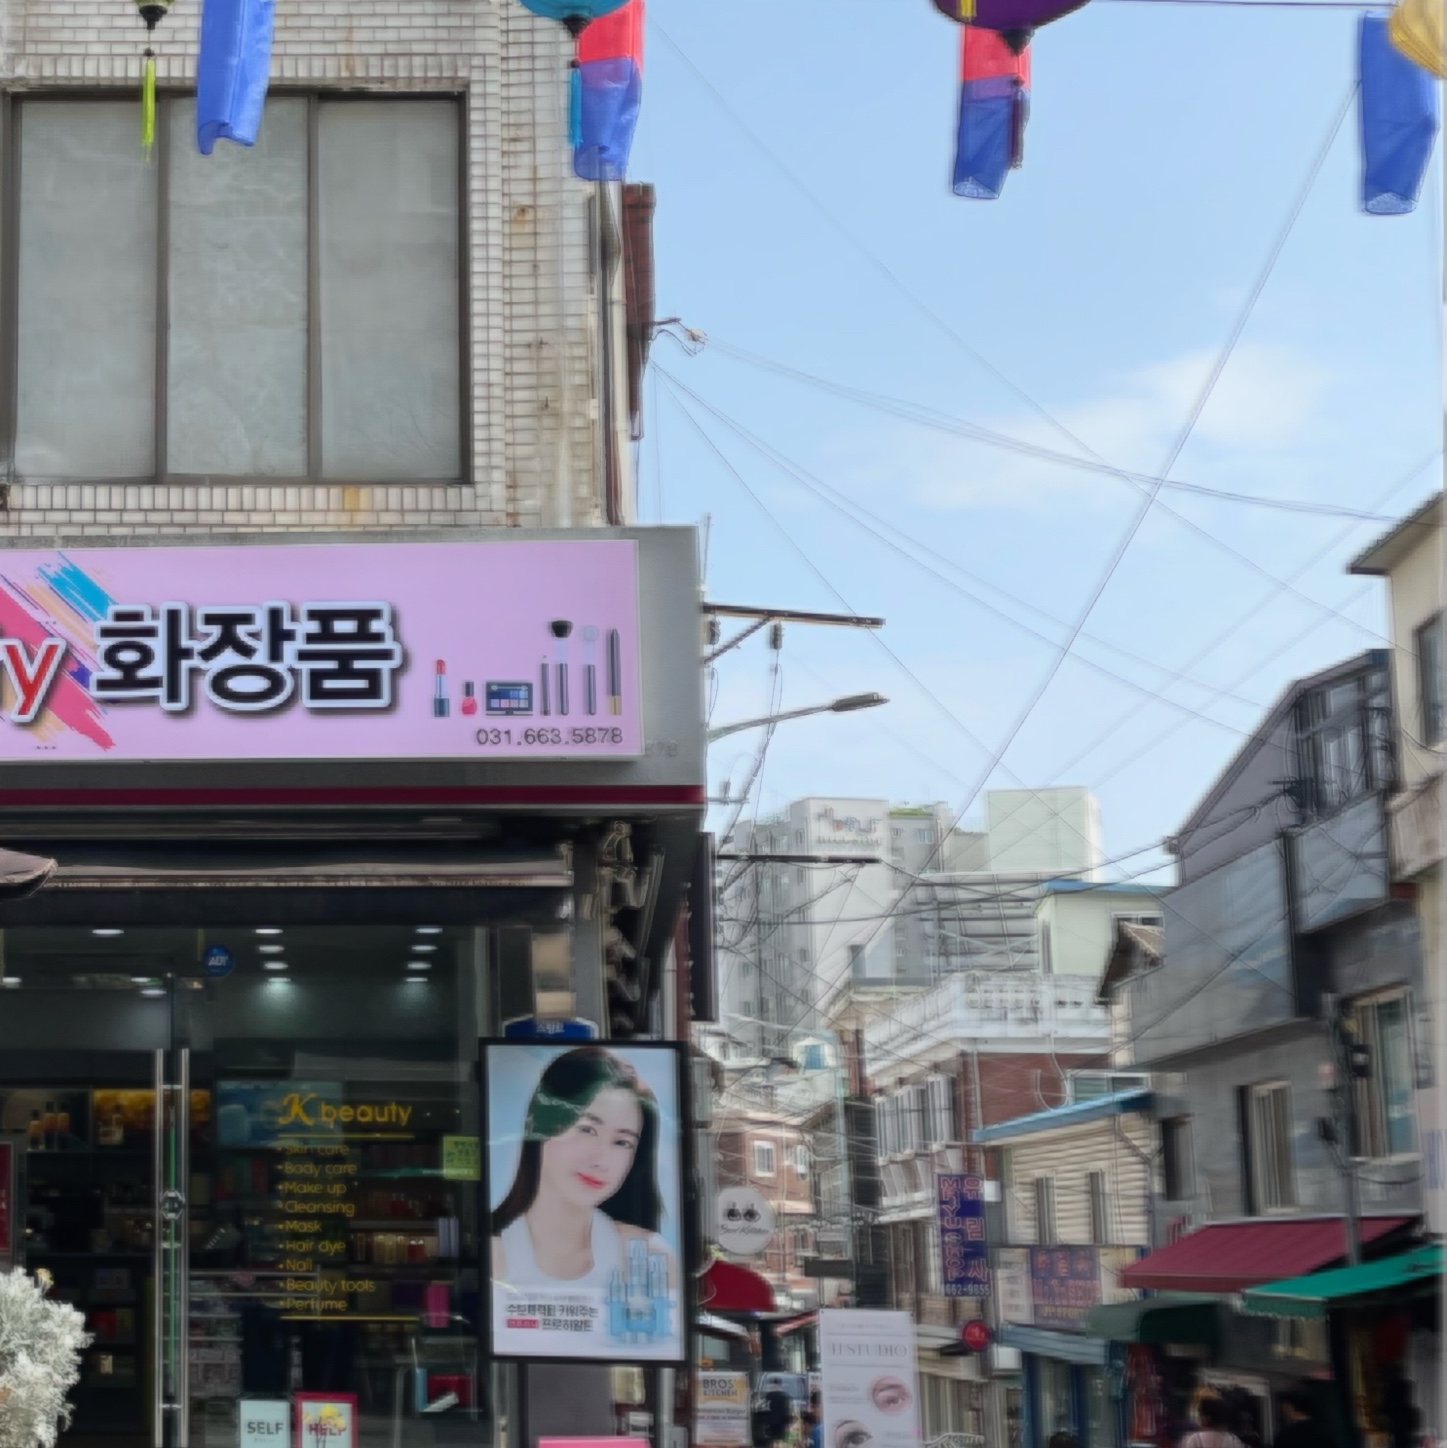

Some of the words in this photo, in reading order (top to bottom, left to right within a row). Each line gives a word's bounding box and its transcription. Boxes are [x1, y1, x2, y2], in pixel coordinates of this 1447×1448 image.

[90, 600, 402, 711] 화장품
[476, 727, 623, 745] 031.663.5878
[208, 955, 229, 967] ADT
[278, 1093, 318, 1125] K
[321, 1102, 412, 1126] beauty
[285, 1144, 315, 1155] Skin
[318, 1146, 350, 1155] care
[285, 1162, 321, 1177] Body
[325, 1164, 357, 1174] care
[285, 1182, 323, 1193] Make
[327, 1185, 347, 1197] up
[285, 1201, 356, 1216] Cleansing
[286, 1221, 323, 1232] Mask
[286, 1240, 314, 1251] Hair
[318, 1240, 346, 1255] dye
[286, 1259, 313, 1270] Nail
[286, 1279, 337, 1294] Beauty
[341, 1279, 376, 1292] tools
[286, 1298, 348, 1311] Perfume
[558, 1304, 599, 1318] 키워주는
[247, 1421, 284, 1435] SELF
